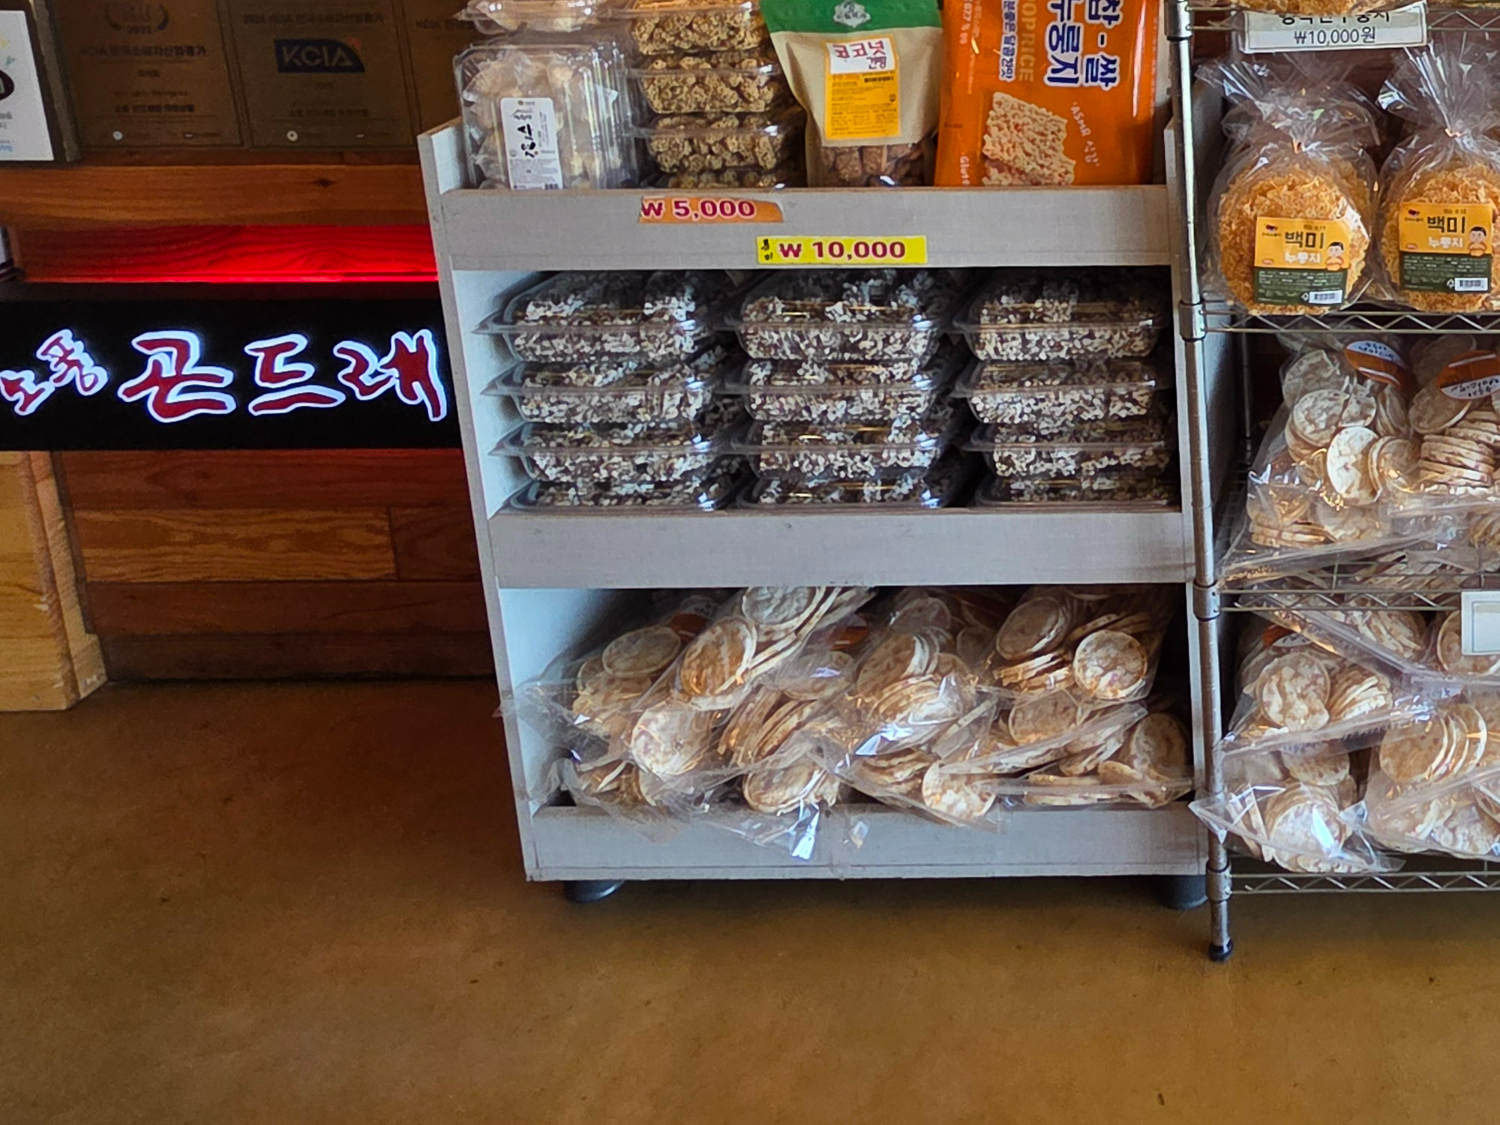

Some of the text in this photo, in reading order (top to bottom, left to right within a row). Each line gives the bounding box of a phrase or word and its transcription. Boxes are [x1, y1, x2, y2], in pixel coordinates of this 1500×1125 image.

[282, 45, 354, 68] KCIA
[673, 198, 756, 220] 5,000
[1426, 215, 1467, 234] 백미
[1284, 230, 1325, 250] 백미
[1427, 236, 1465, 250] 누룽지
[811, 240, 906, 261] 10,000
[1284, 250, 1321, 265] 누룽지
[118, 328, 448, 423] 곤드레
